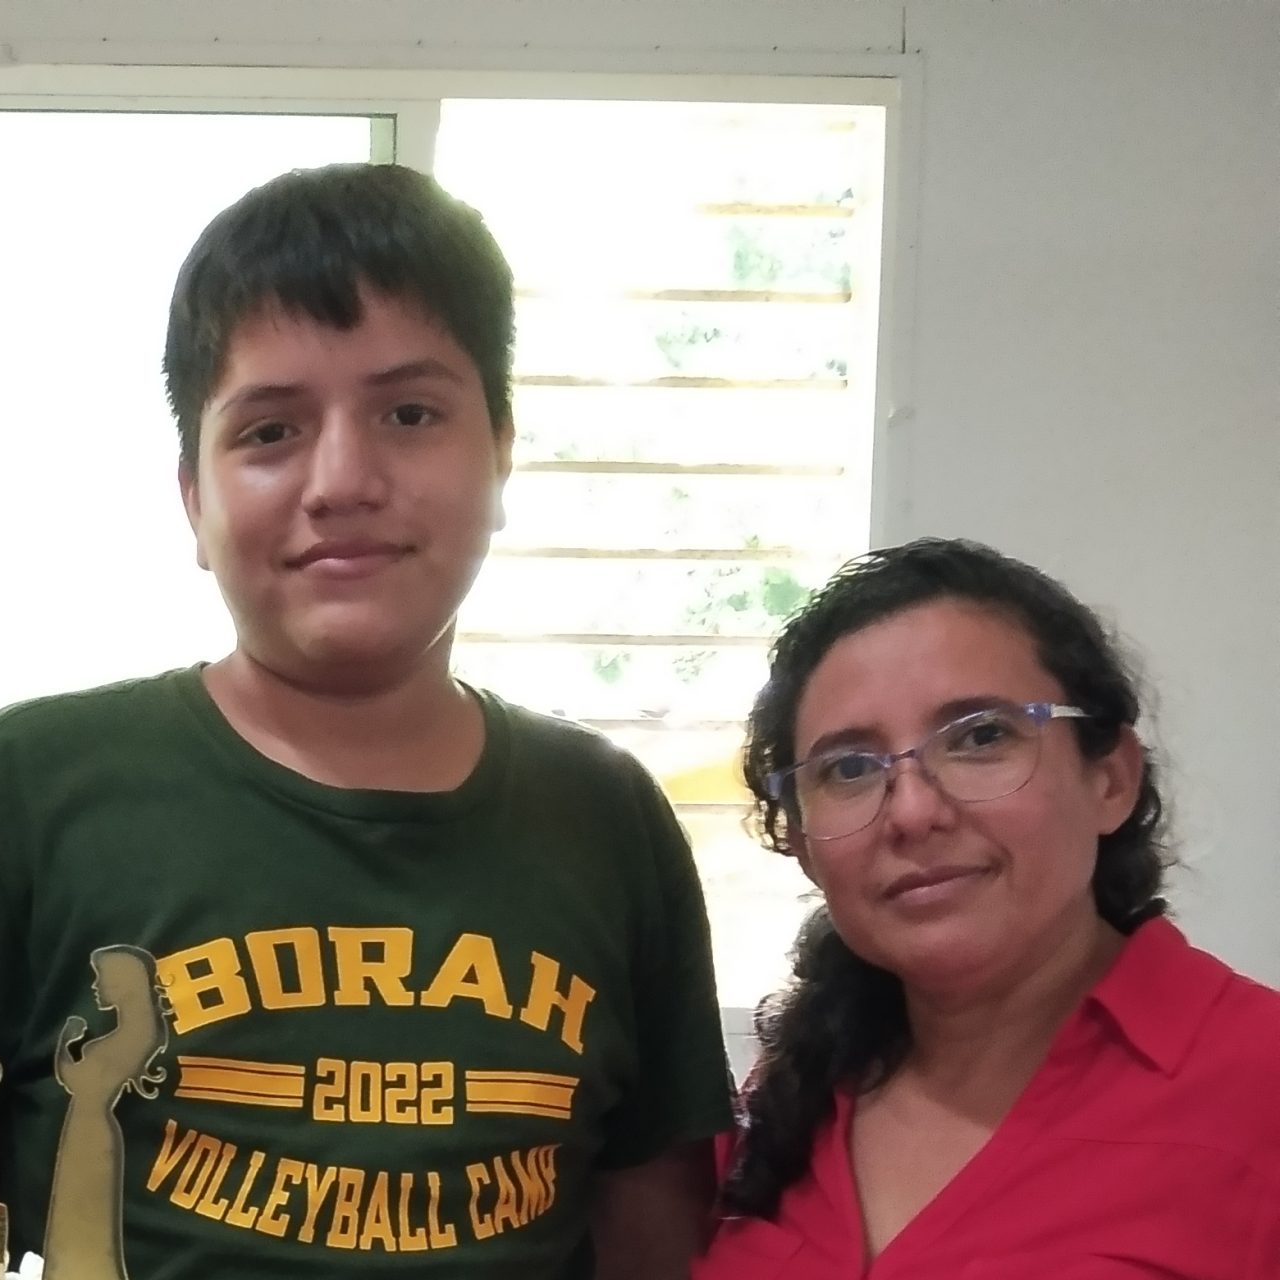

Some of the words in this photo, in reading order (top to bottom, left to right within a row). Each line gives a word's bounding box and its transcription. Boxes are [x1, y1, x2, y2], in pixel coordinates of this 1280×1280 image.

[156, 926, 596, 1055] BORAH
[312, 1057, 455, 1125] 2022
[146, 1118, 457, 1252] VOLLEYBALL
[465, 1143, 562, 1241] CAMP
